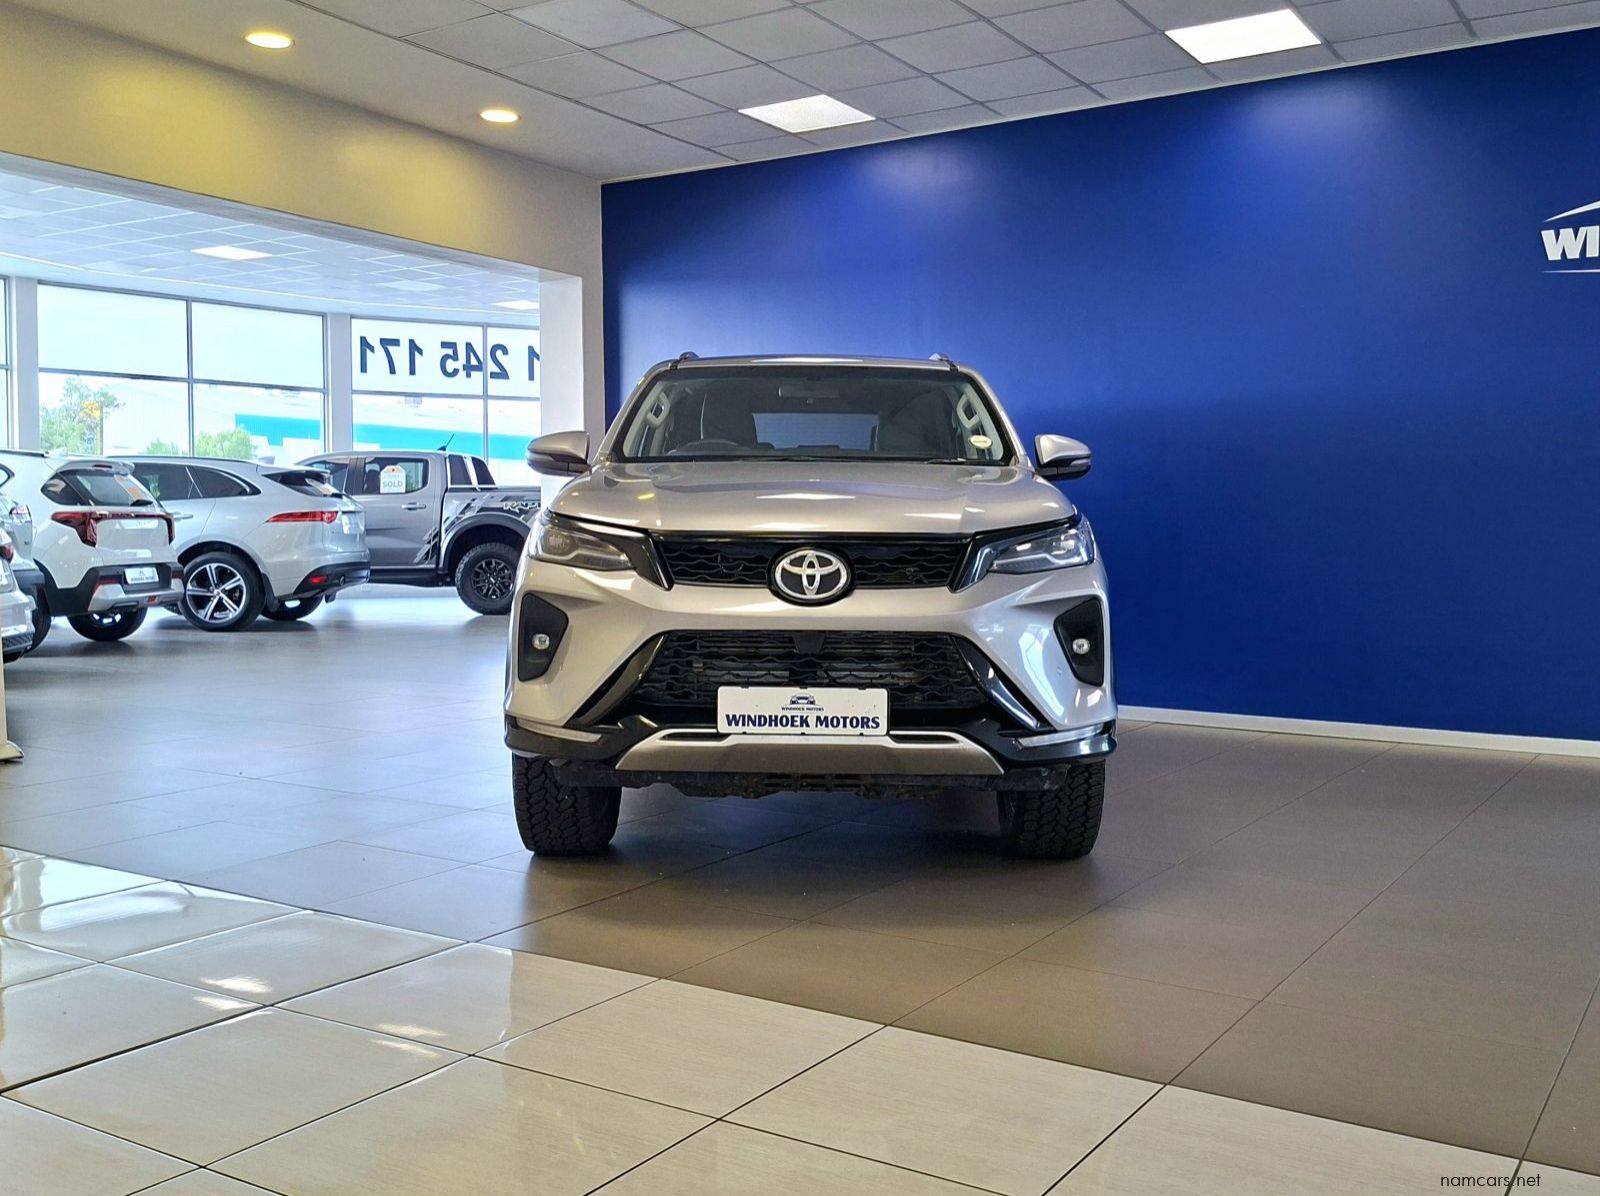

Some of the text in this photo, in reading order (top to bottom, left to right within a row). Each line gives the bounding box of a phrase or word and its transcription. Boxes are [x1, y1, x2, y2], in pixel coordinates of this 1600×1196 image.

[382, 480, 403, 488] SOLD
[725, 714, 880, 729] WINDHOEK MOTORS
